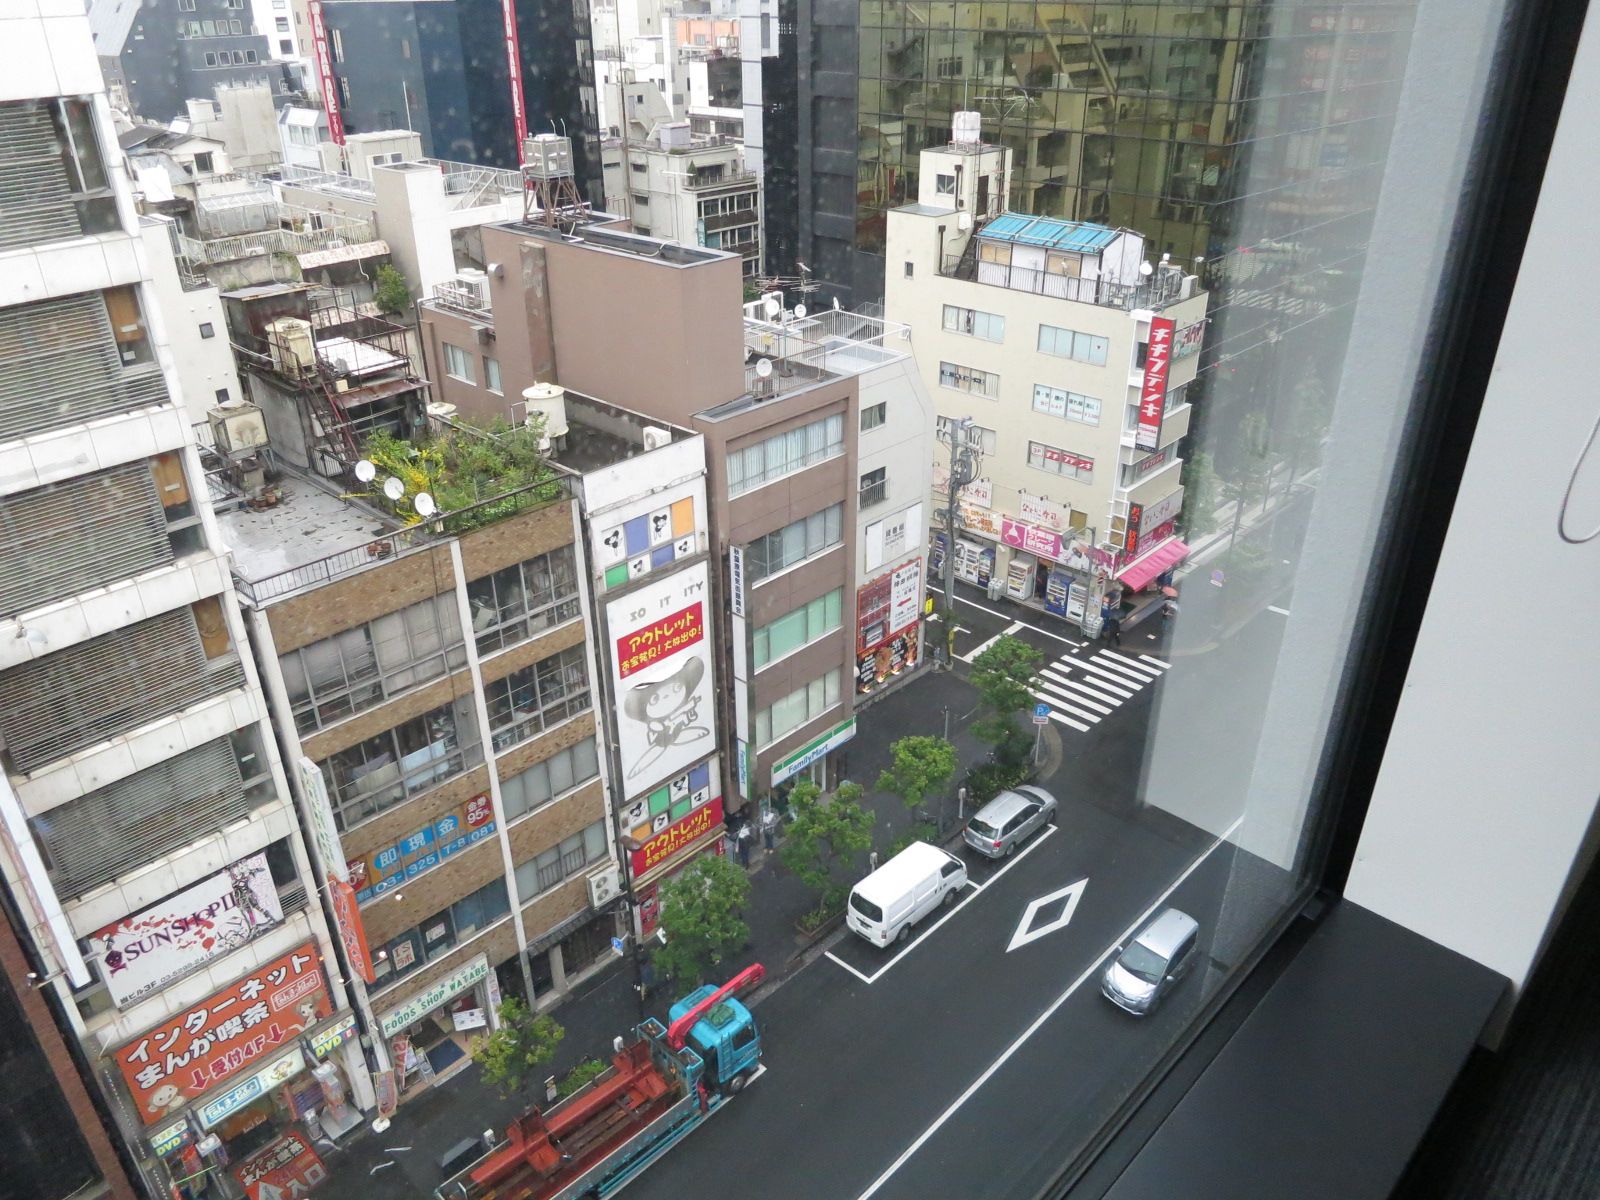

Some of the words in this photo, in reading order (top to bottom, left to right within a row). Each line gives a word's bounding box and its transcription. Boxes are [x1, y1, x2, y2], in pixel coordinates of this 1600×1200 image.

[1141, 328, 1170, 418] チチブデンキ
[629, 611, 695, 653] アウトレット
[788, 744, 828, 774] FamilyMart
[380, 818, 455, 868] 即現金
[643, 807, 712, 858] アウトレット
[127, 954, 311, 1064] インターネット
[384, 1009, 417, 1034] FOODS
[421, 989, 446, 1011] SHOP
[449, 962, 487, 992] WATABE
[134, 1000, 270, 1089] まんが喫茶
[208, 1034, 267, 1080] 受付4F
[314, 1034, 342, 1058] DVD
[156, 1135, 182, 1156] DVD
